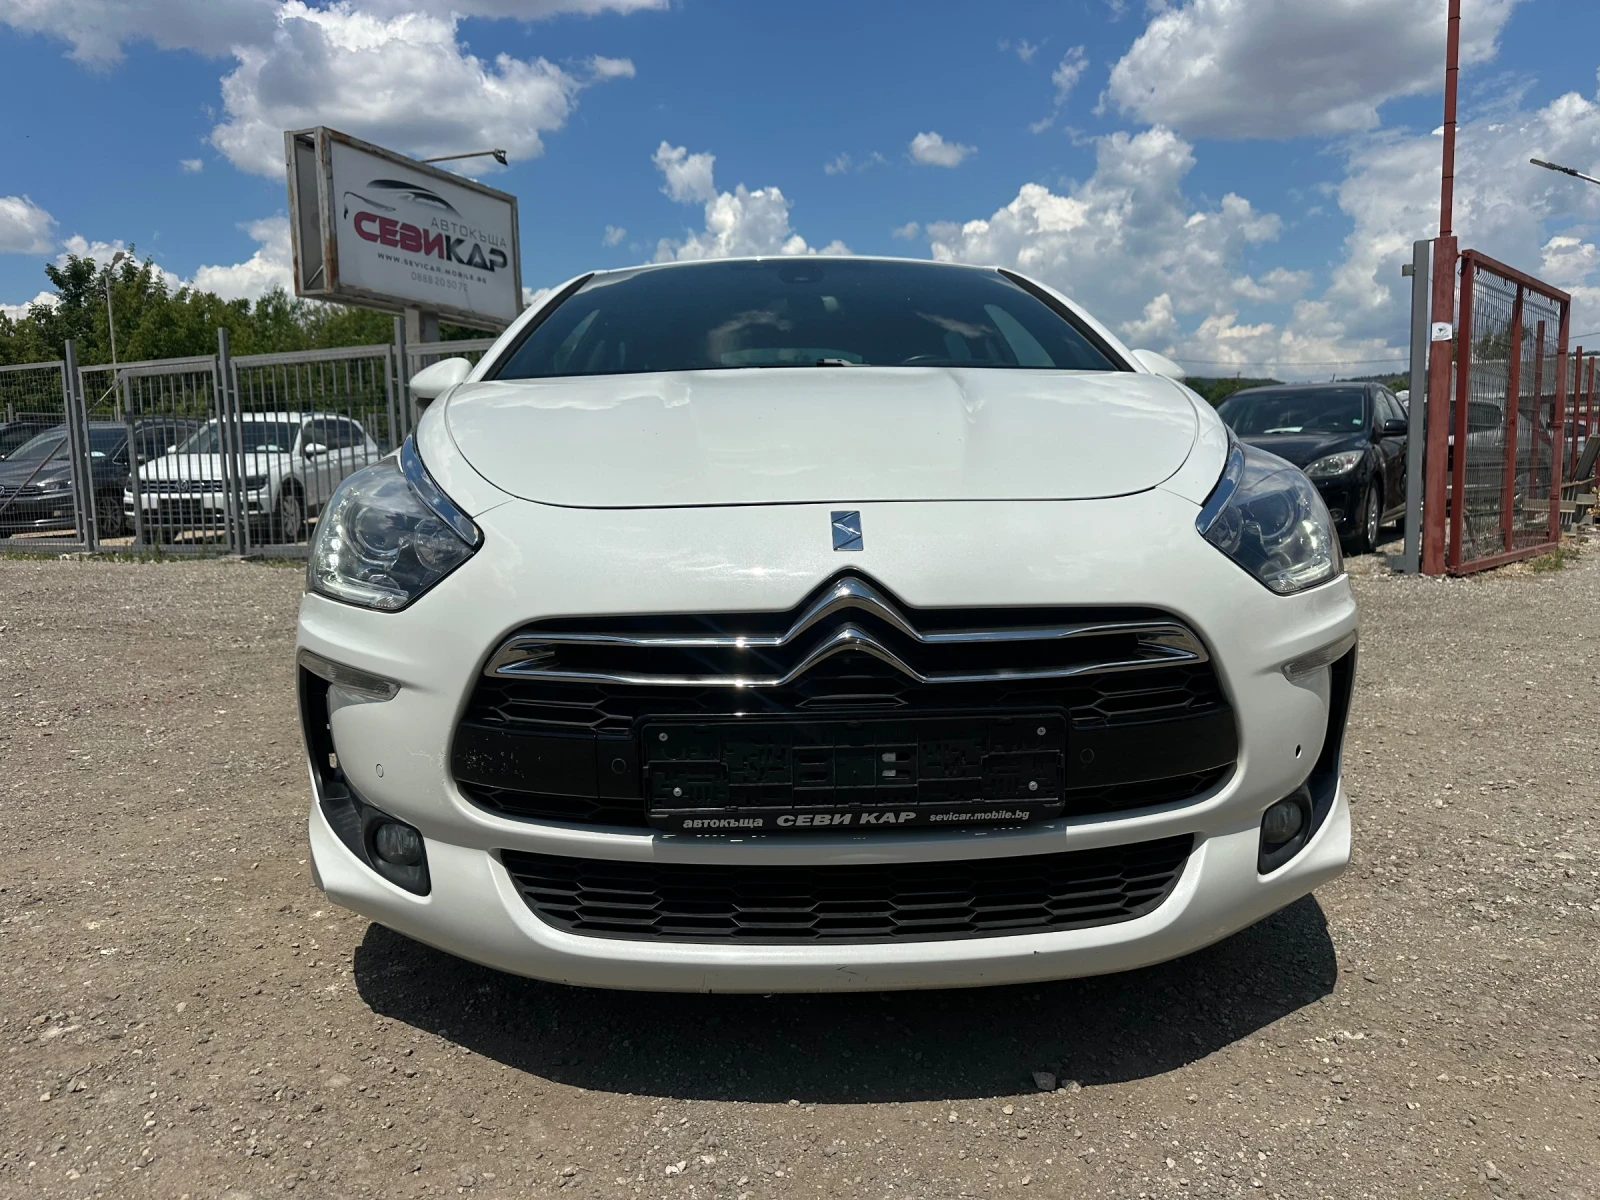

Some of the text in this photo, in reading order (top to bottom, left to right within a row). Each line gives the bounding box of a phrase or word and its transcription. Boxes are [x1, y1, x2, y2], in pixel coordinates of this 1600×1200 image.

[431, 217, 507, 249] АВТОКЪЩА
[377, 252, 487, 284] WWW.SEVICAR.MOBILE.BG
[682, 810, 1030, 828] автокъща СЕВИ КАР sevicar.mobile.bg
